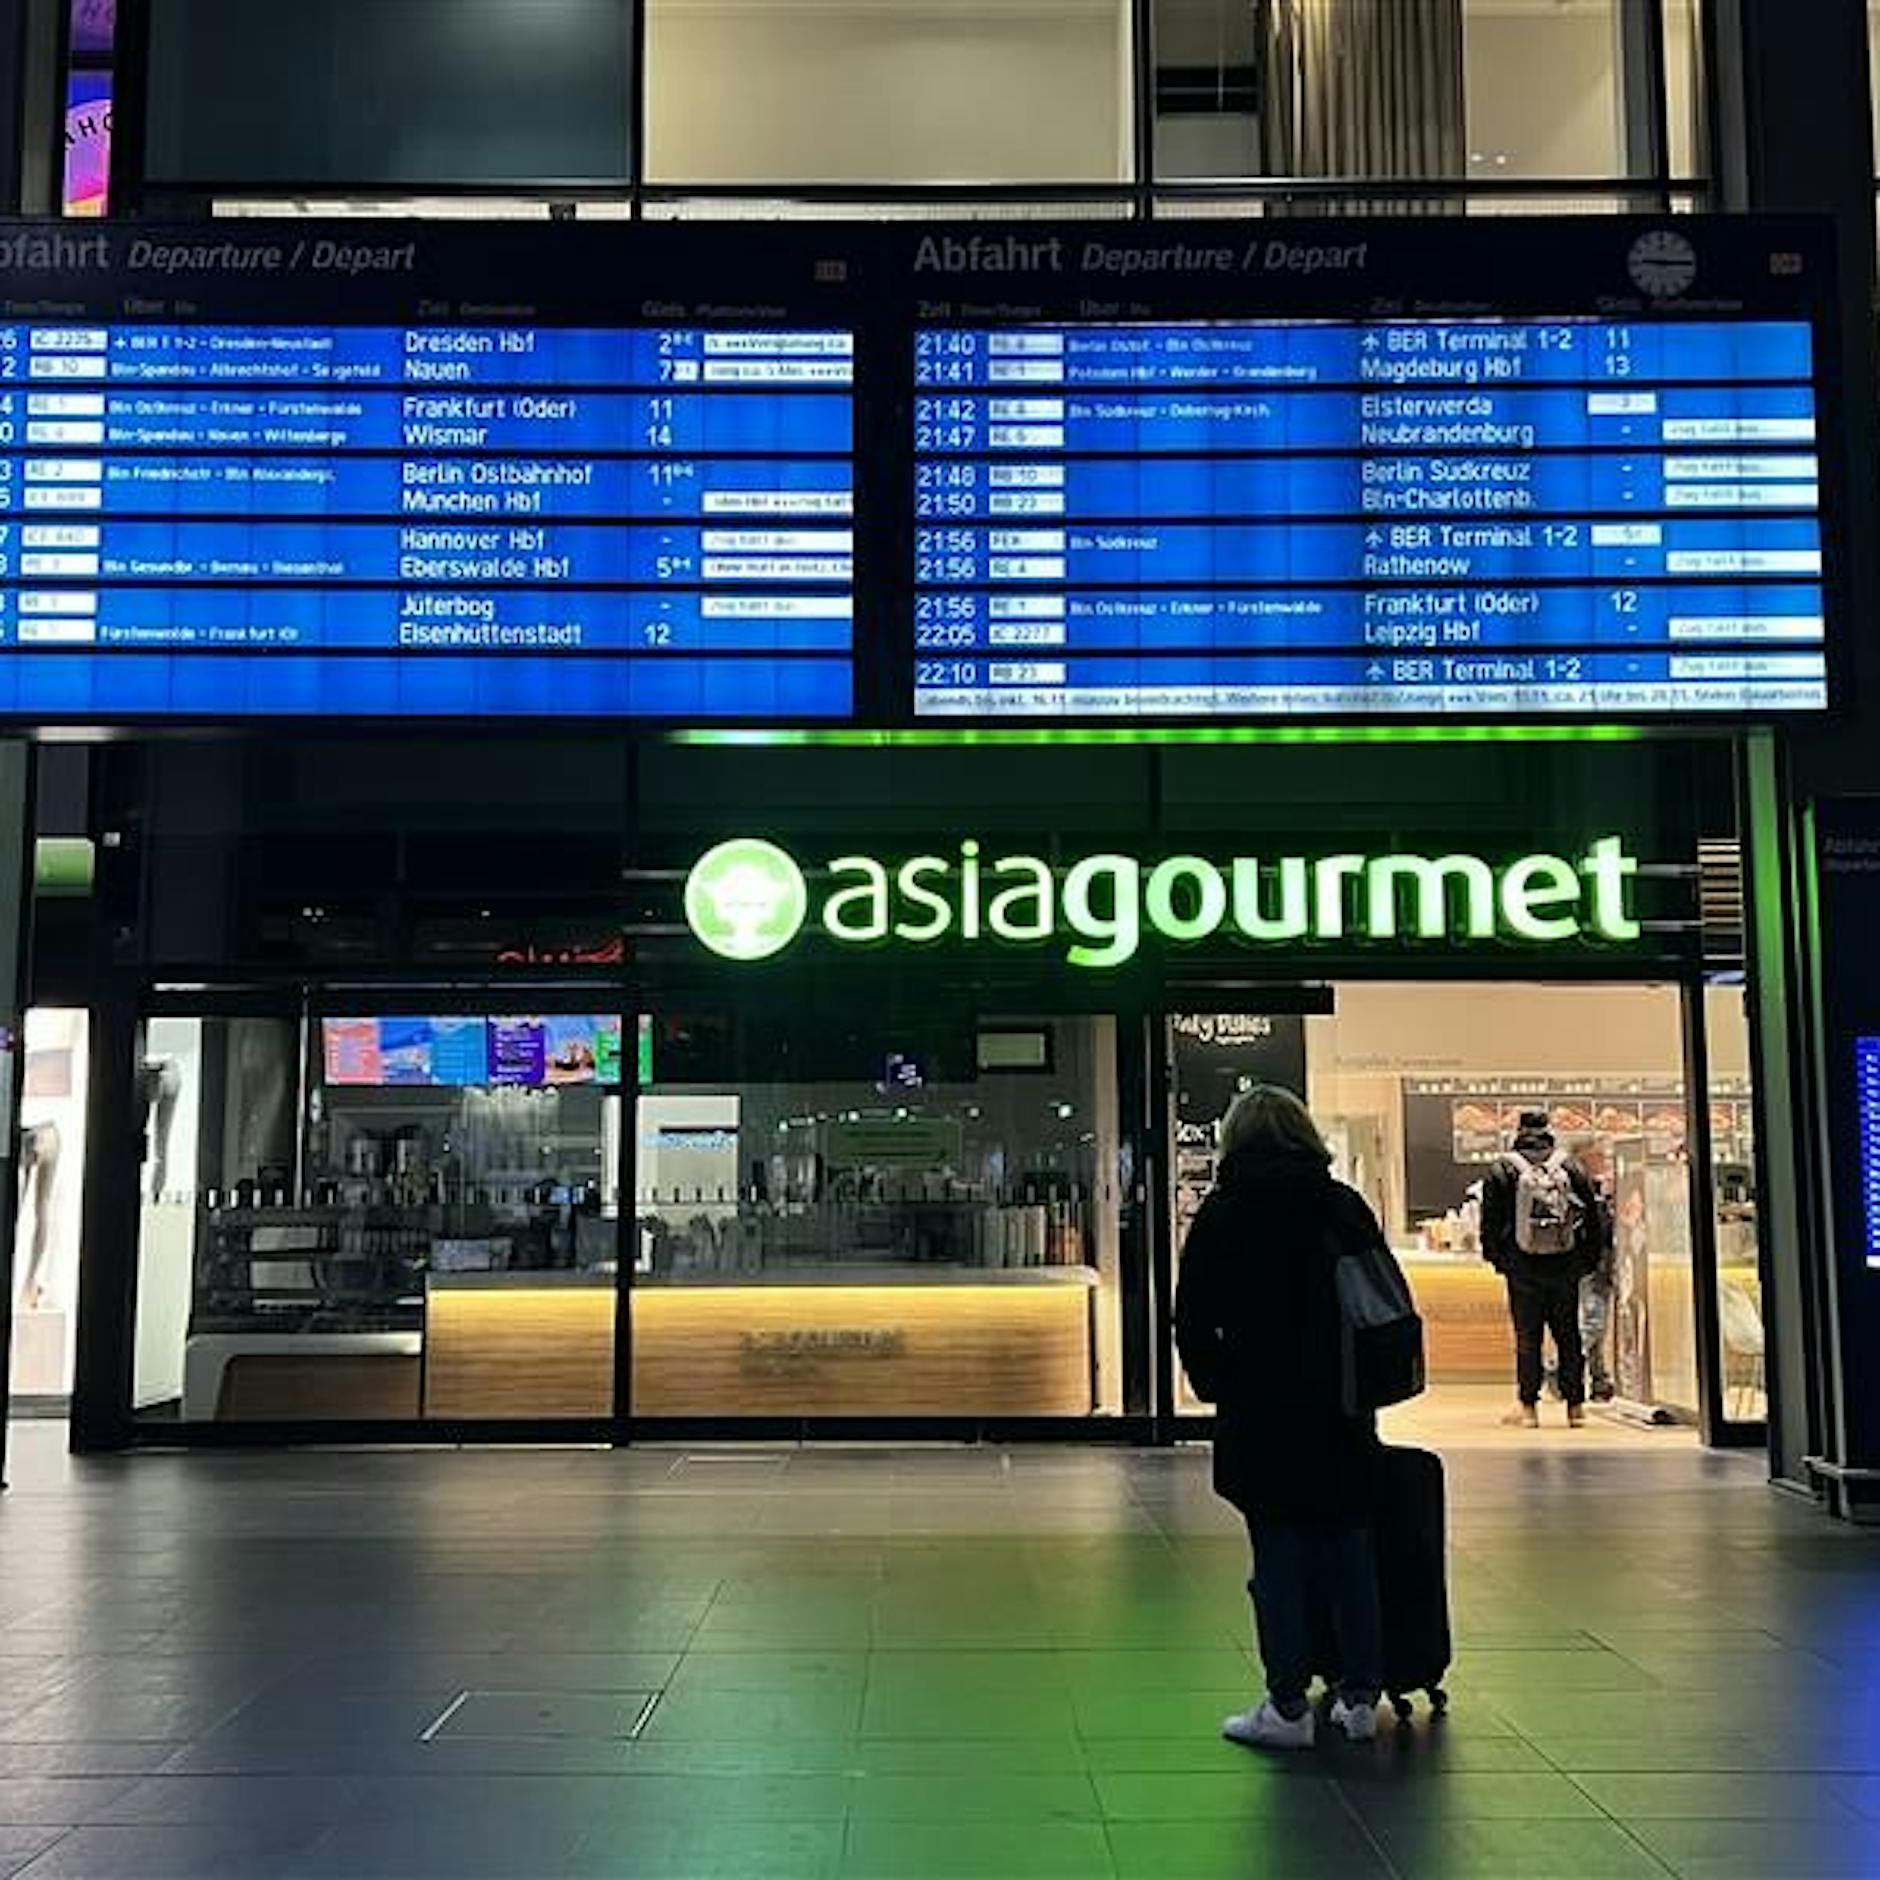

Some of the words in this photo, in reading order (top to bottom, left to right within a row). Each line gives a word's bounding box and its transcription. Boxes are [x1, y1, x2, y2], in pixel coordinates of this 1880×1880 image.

[128, 240, 281, 274] Departure
[914, 237, 1061, 270] Abfahrt
[1082, 242, 1233, 276] Departure
[405, 330, 492, 353] Dresden
[499, 331, 534, 353] Hbf
[917, 333, 976, 356] 21:40
[1388, 329, 1427, 352] BER
[1437, 328, 1526, 351] Terminal
[1539, 327, 1573, 349] 1-2
[1607, 328, 1630, 349] 11
[405, 359, 470, 381] Nauen
[917, 361, 973, 382] 21:41
[1361, 357, 1479, 384] Magdeburg
[1484, 356, 1521, 378] Hbf
[1605, 354, 1631, 377] 13
[403, 396, 505, 419] Frankfurt
[512, 396, 577, 420] (Oder)
[649, 398, 673, 420] 11
[917, 399, 976, 421] 21:42
[1361, 396, 1493, 418] Elsterwerda
[403, 423, 488, 446] Wismar
[647, 425, 672, 446] 14
[917, 425, 976, 448] 21:47
[1361, 422, 1534, 448] Neubrandenburg
[402, 462, 464, 484] Berlin
[471, 462, 592, 485] Ostbahnhof
[918, 465, 976, 487] 21:48
[1362, 460, 1424, 483] Berlin
[504, 490, 541, 512] Hbf
[917, 492, 976, 515] 21:50
[401, 528, 500, 551] Hannover
[509, 529, 544, 550] Hbf
[918, 530, 976, 553] 21:56
[1390, 525, 1431, 549] BER
[1440, 525, 1532, 547] Terminal
[1543, 524, 1578, 547] 1-2
[400, 555, 527, 578] Eberswalde
[533, 556, 569, 578] Hbf
[917, 556, 976, 580] 21:56
[1364, 553, 1471, 576] Rathenow
[917, 596, 976, 619] 21:56
[1365, 593, 1466, 615] Frankfurt
[1474, 592, 1539, 616] (Oder)
[1611, 590, 1637, 613] 12
[644, 622, 671, 646] 12
[917, 622, 976, 647] 22:05
[1364, 621, 1437, 647] Leipzig
[1443, 619, 1480, 641] Hbf
[917, 662, 976, 685] 22:10
[1393, 659, 1434, 682] BER
[1442, 657, 1534, 681] Terminal
[1546, 657, 1581, 680] 1-2
[823, 837, 1639, 966] asiagourmet
